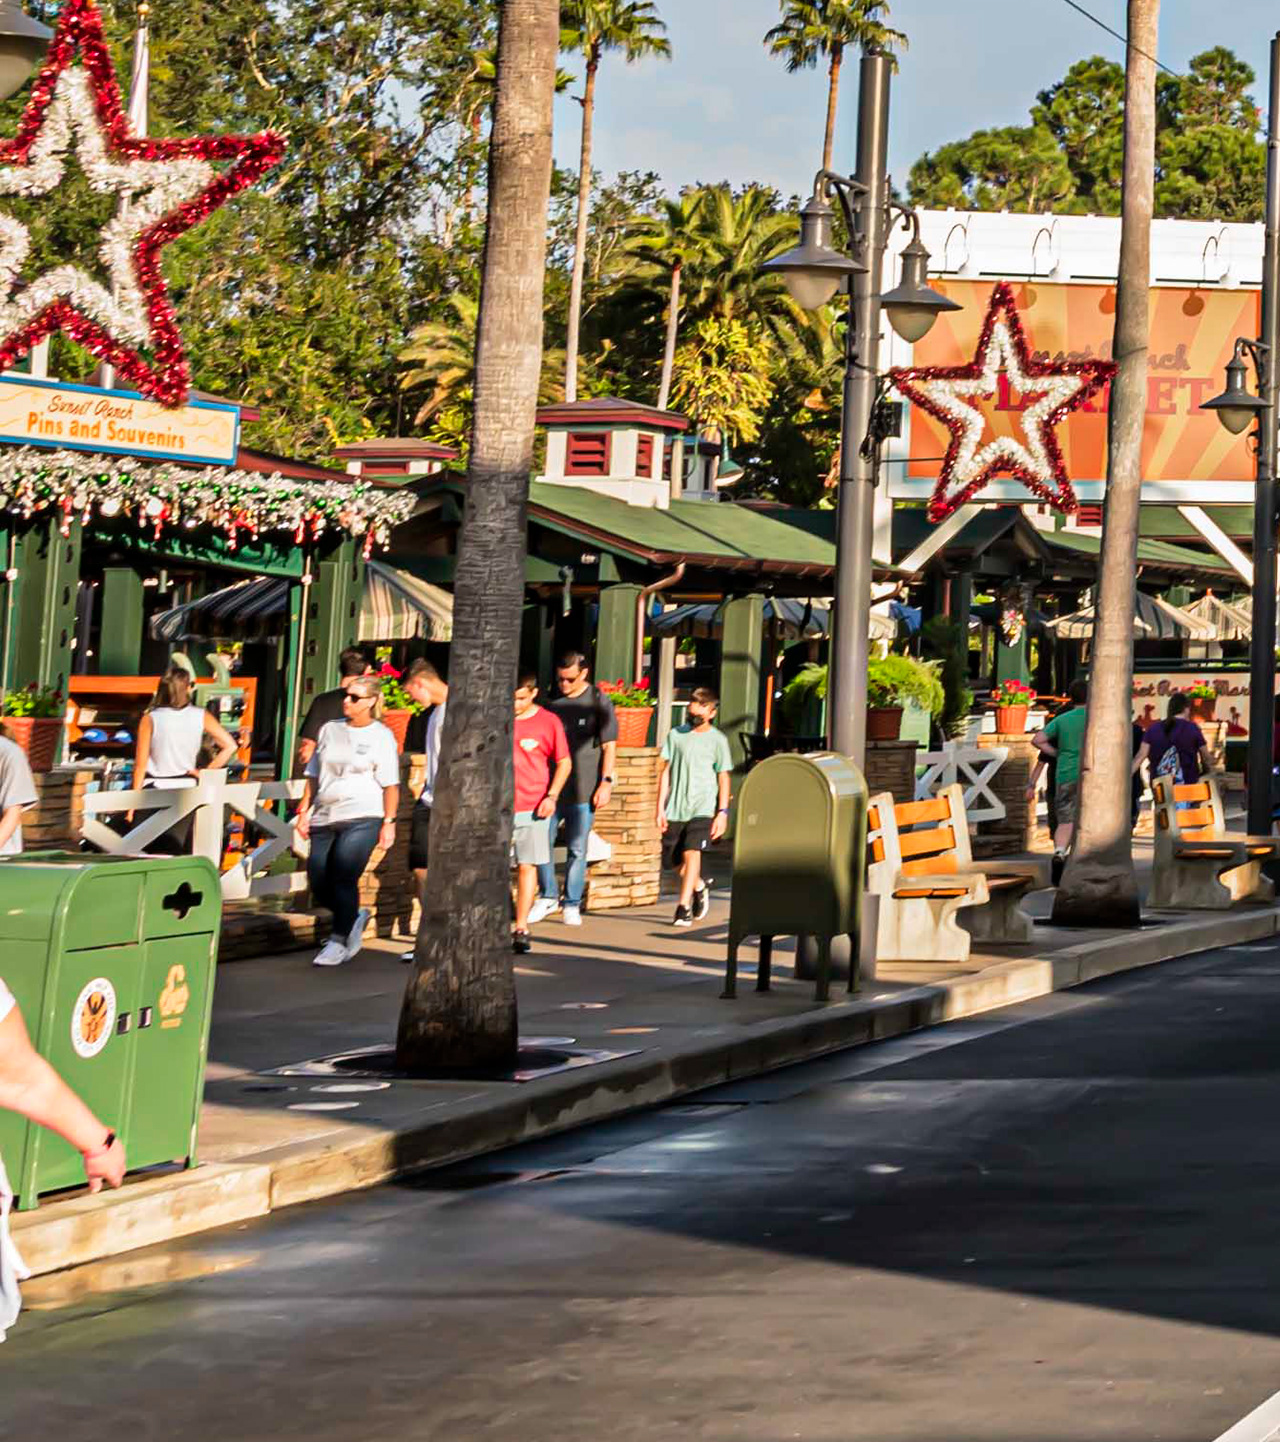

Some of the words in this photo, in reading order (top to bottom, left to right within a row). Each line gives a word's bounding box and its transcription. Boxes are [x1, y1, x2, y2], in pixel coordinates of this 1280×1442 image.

[47, 394, 93, 415] Sunset
[94, 398, 134, 421] Ranch
[26, 411, 64, 435] Pins
[69, 419, 101, 439] and
[106, 420, 186, 450] Souvenirs
